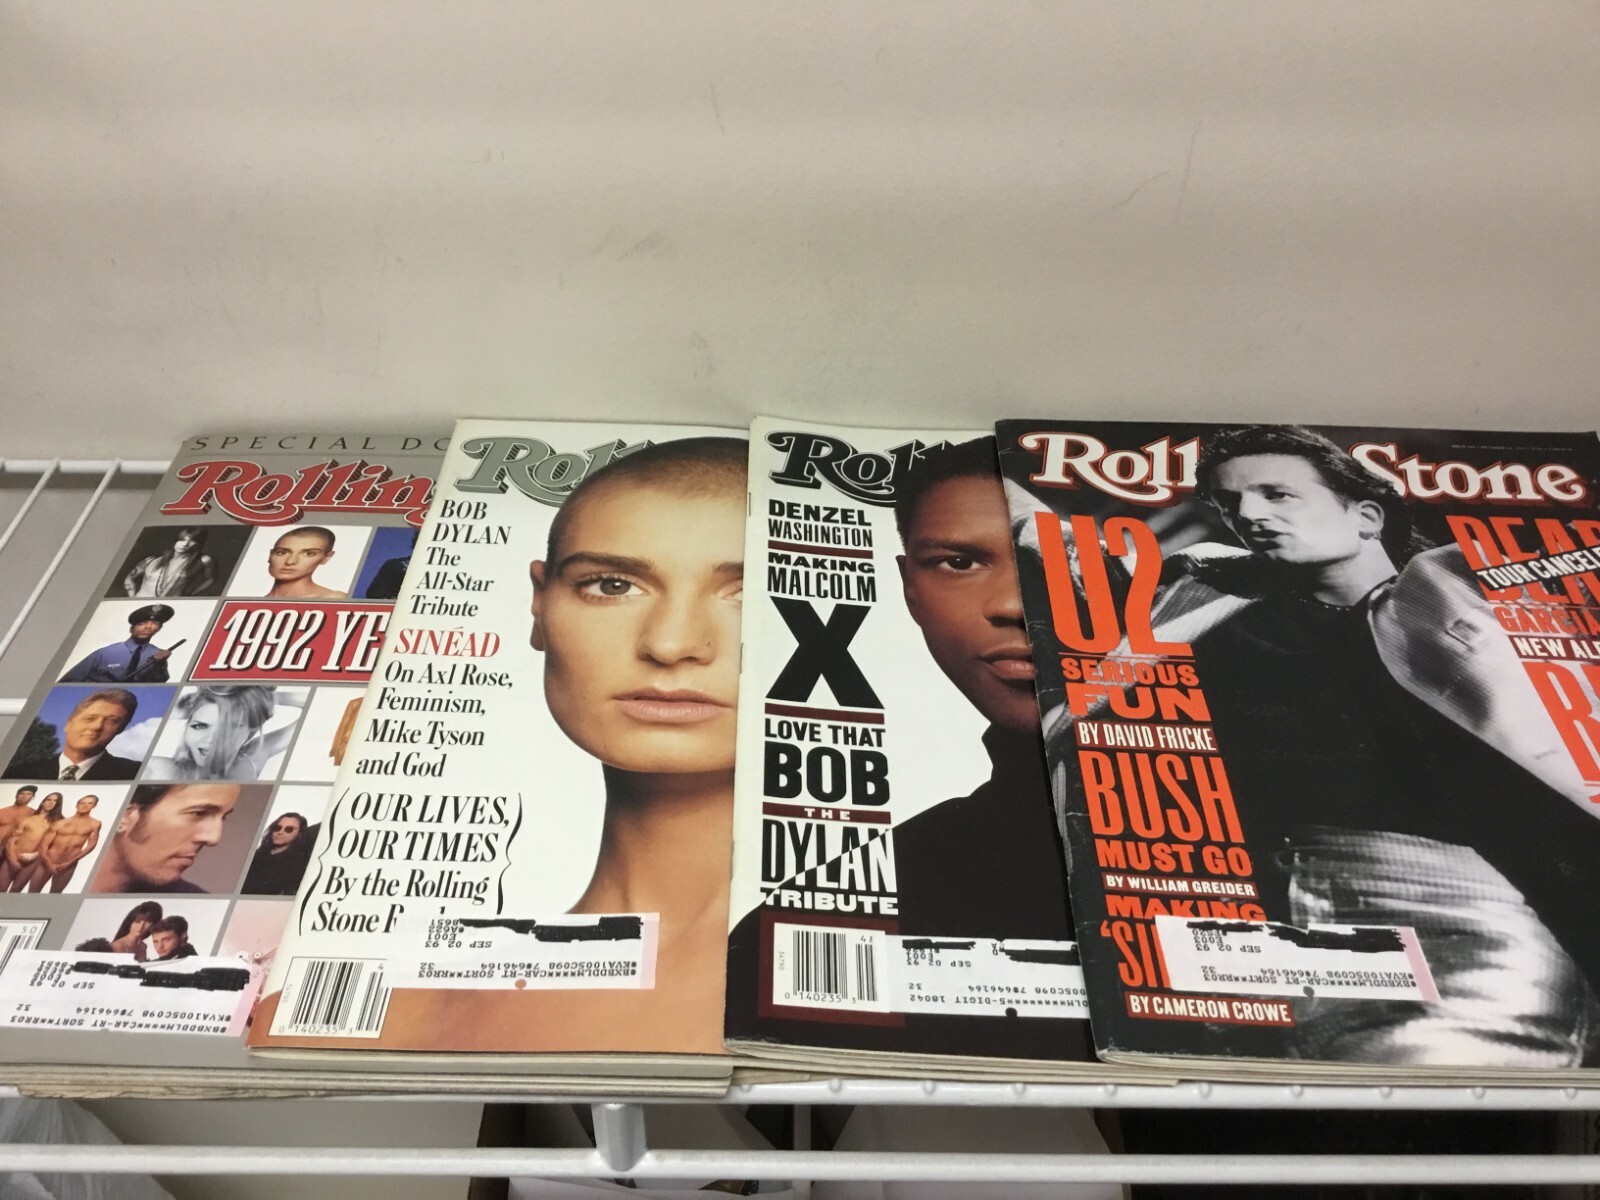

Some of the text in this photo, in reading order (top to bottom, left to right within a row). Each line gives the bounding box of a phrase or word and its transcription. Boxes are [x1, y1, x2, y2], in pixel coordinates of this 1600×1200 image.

[191, 436, 376, 450] SPECIAL
[453, 436, 654, 508] Rol
[765, 431, 953, 507] Rol
[1349, 442, 1588, 504] Stone
[440, 500, 487, 520] BOB
[768, 498, 872, 526] DENZEL
[431, 523, 512, 545] DYLAN
[768, 518, 873, 547] WASHINGTON
[426, 547, 461, 567] The
[768, 552, 875, 574] MAKING
[416, 571, 494, 592] All-Star
[767, 565, 877, 602] MALCOLM
[1034, 511, 1193, 656] U2
[1477, 563, 1538, 588] TOUR
[410, 595, 479, 617] Tribute
[209, 609, 319, 672] 1992
[394, 627, 500, 658] SINÉAD
[765, 596, 885, 709] X
[1513, 637, 1567, 657] NEW
[384, 660, 513, 688] On Axl Rose,
[1060, 657, 1200, 686] SERIOUS
[376, 687, 486, 716] Feminism,
[1065, 682, 1212, 721] FUN
[365, 719, 484, 750] Mike Tyson
[764, 718, 886, 748] LOVE THAT
[1078, 722, 1216, 750] BY DAVID FRICKE
[355, 752, 447, 777] and God
[763, 740, 890, 807] BOB
[351, 792, 510, 828] OUR LIVES,
[1077, 750, 1245, 843] BUSH
[804, 808, 851, 821] THE
[337, 829, 498, 863] OUR TIMES
[761, 818, 898, 893] DYLAN
[1094, 838, 1253, 877] MUST GO
[322, 866, 489, 905] By the Rolling
[1106, 875, 1255, 896] BY WILLIAM GREIDER
[760, 886, 899, 916] TRIBUTE
[1105, 894, 1267, 923] MAKING
[311, 901, 379, 933] Stone
[424, 940, 439, 948] 93
[1240, 945, 1261, 953] SEP
[420, 962, 435, 970] 32
[906, 958, 919, 966] 93
[950, 960, 971, 968] SEP
[1201, 965, 1215, 973] 32
[16, 1003, 31, 1012] 32
[799, 993, 841, 1003] 140235
[910, 994, 945, 1003] 18042
[1129, 996, 1292, 1022] BY CAMERON CROWE
